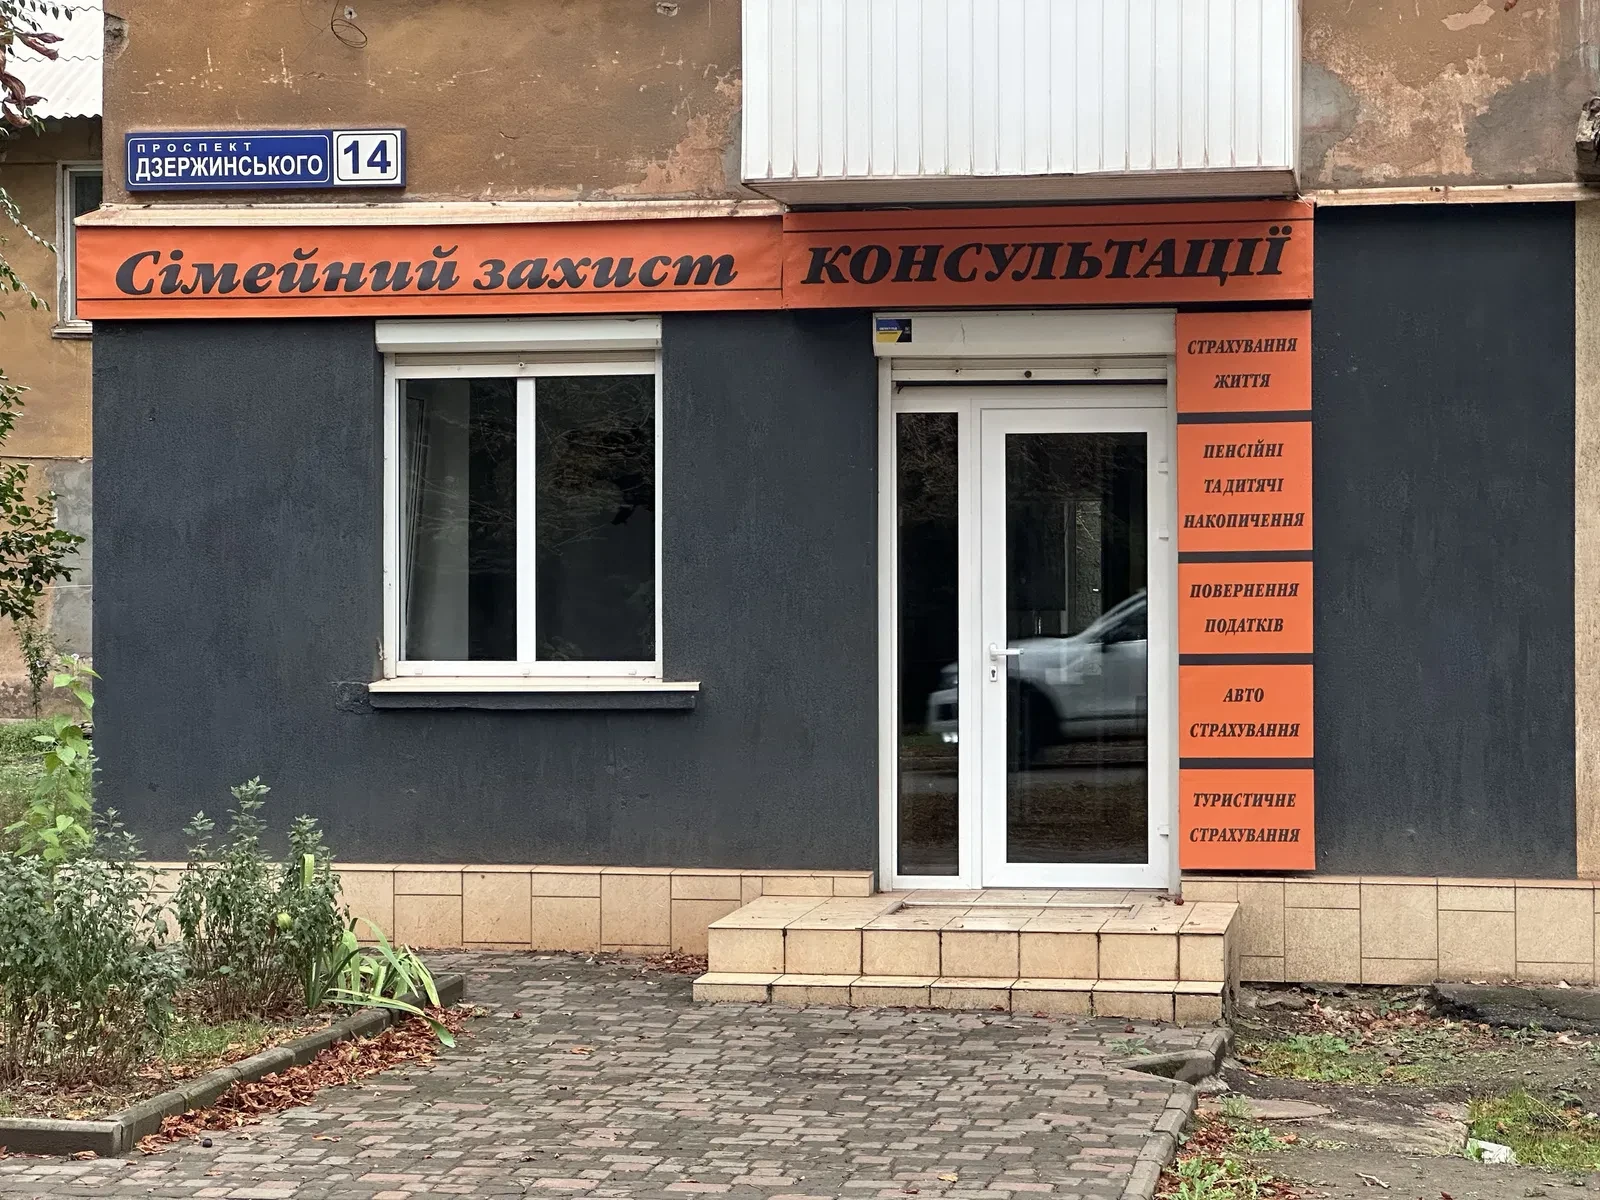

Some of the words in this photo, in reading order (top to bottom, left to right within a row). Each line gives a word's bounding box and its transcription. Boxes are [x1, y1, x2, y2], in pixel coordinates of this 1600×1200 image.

[137, 142, 252, 153] ПРОСПЕКТ
[343, 139, 392, 175] 14
[135, 154, 323, 182] ДЗЕРЖИНСЬКОГО
[801, 225, 1293, 287] КОНСУЛЬТАЦІЇ
[115, 245, 461, 296] Сімейний
[473, 252, 738, 291] захист
[1187, 337, 1298, 355] СТРАХУВАННЯ
[1213, 373, 1272, 389] ЖИТТЯ
[1203, 439, 1284, 459] ПЕНСІЙНІ
[1184, 512, 1305, 529] НАКОПИЧЕННЯ
[1189, 582, 1300, 599] ПОВЕРНЕННЯ
[1204, 617, 1284, 635] ПОДАТКІВ
[1223, 687, 1265, 703] АВТО
[1189, 722, 1300, 738] СТРАХУВАННЯ
[1193, 792, 1297, 808] ТУРИСТИЧНЕ
[1189, 827, 1301, 843] СТРАХУВАННЯ
